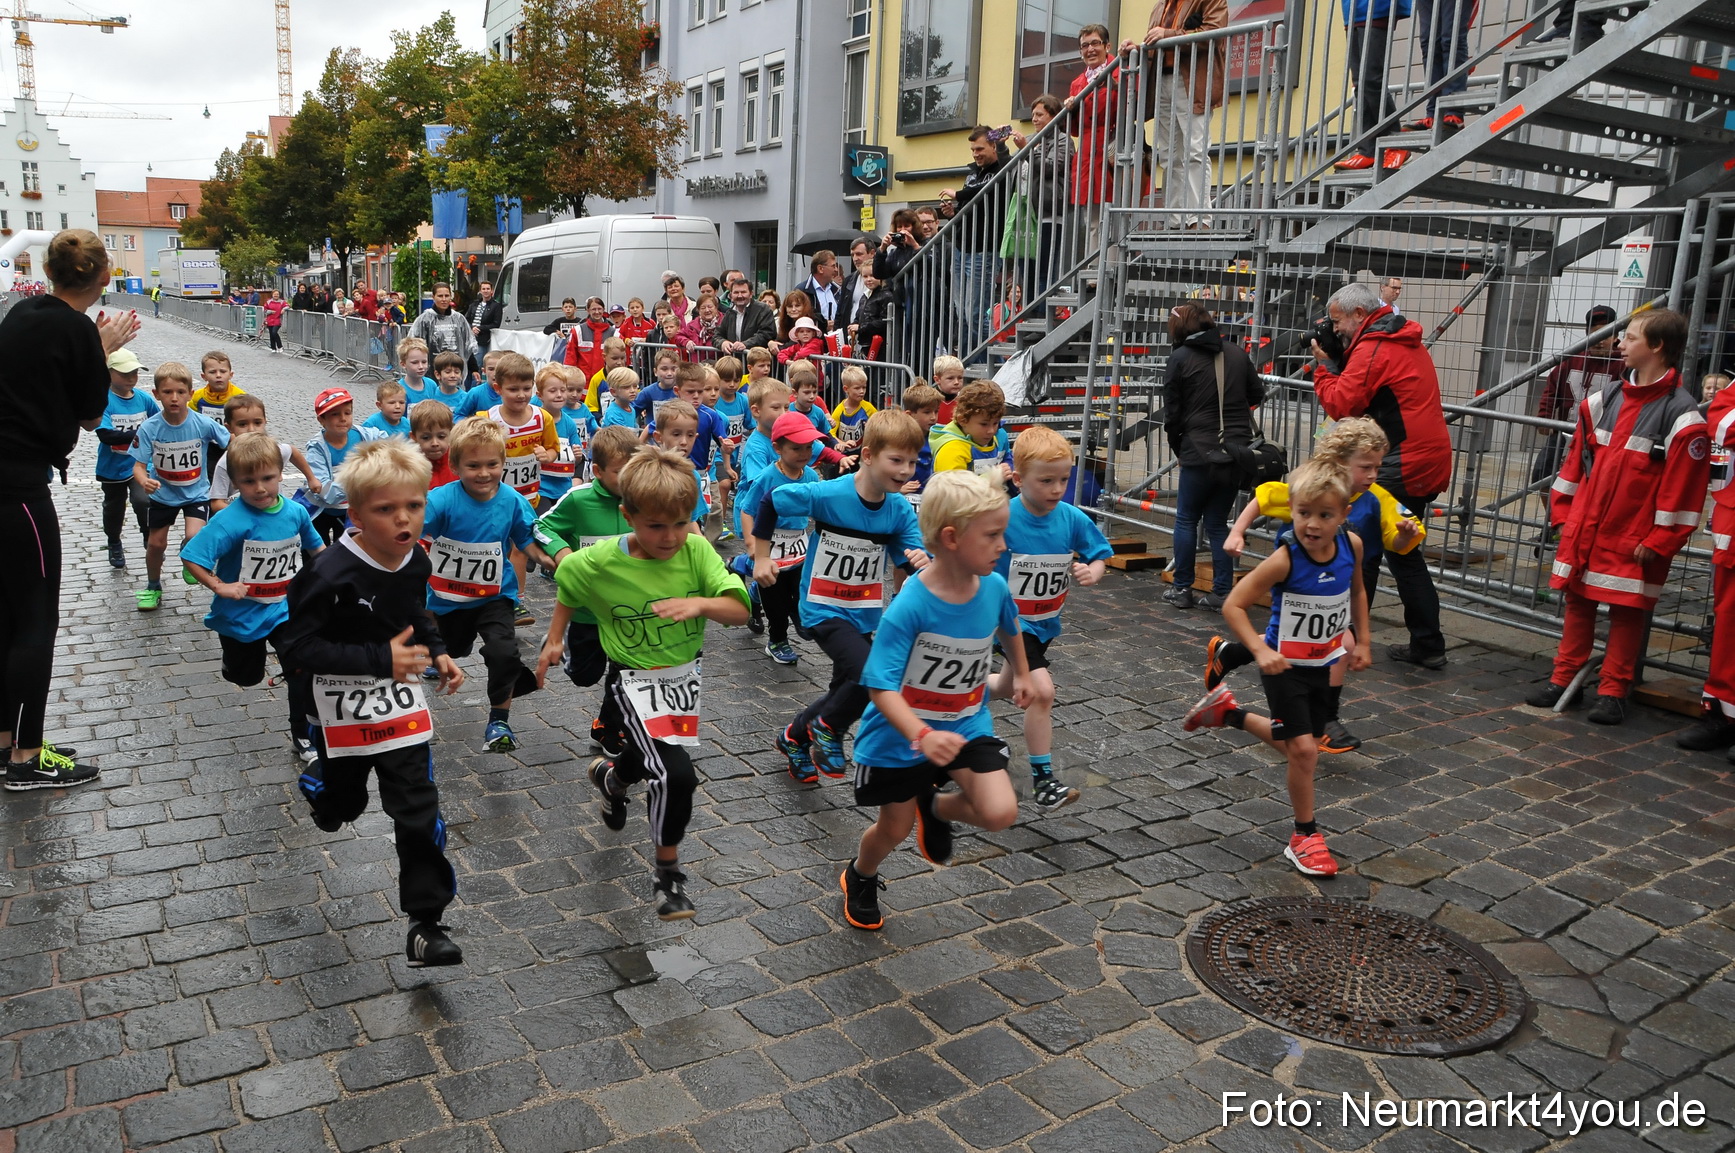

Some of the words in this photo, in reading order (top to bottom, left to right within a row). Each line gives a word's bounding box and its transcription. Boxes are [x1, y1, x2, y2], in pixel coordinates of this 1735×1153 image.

[182, 260, 217, 269] BOCK
[505, 442, 518, 450] AX
[156, 451, 199, 470] 7146
[501, 464, 538, 485] 7134
[245, 546, 271, 554] PARTL
[434, 540, 456, 552] PARTL
[457, 547, 494, 556] Neumarkt
[821, 537, 845, 551] PARTL
[847, 544, 881, 553] Neumarkt
[250, 551, 298, 580] 7224
[437, 550, 497, 582] 7170
[823, 550, 881, 582] 7041
[1012, 560, 1039, 569] PARTL
[447, 582, 477, 596] Kilian
[833, 585, 862, 599] Lukas
[1284, 599, 1313, 610] PARTL
[1290, 607, 1347, 640] 7082
[917, 639, 953, 655] PARTL
[315, 676, 351, 687] PARTL
[324, 680, 415, 721] 7236
[360, 725, 395, 742] Timo
